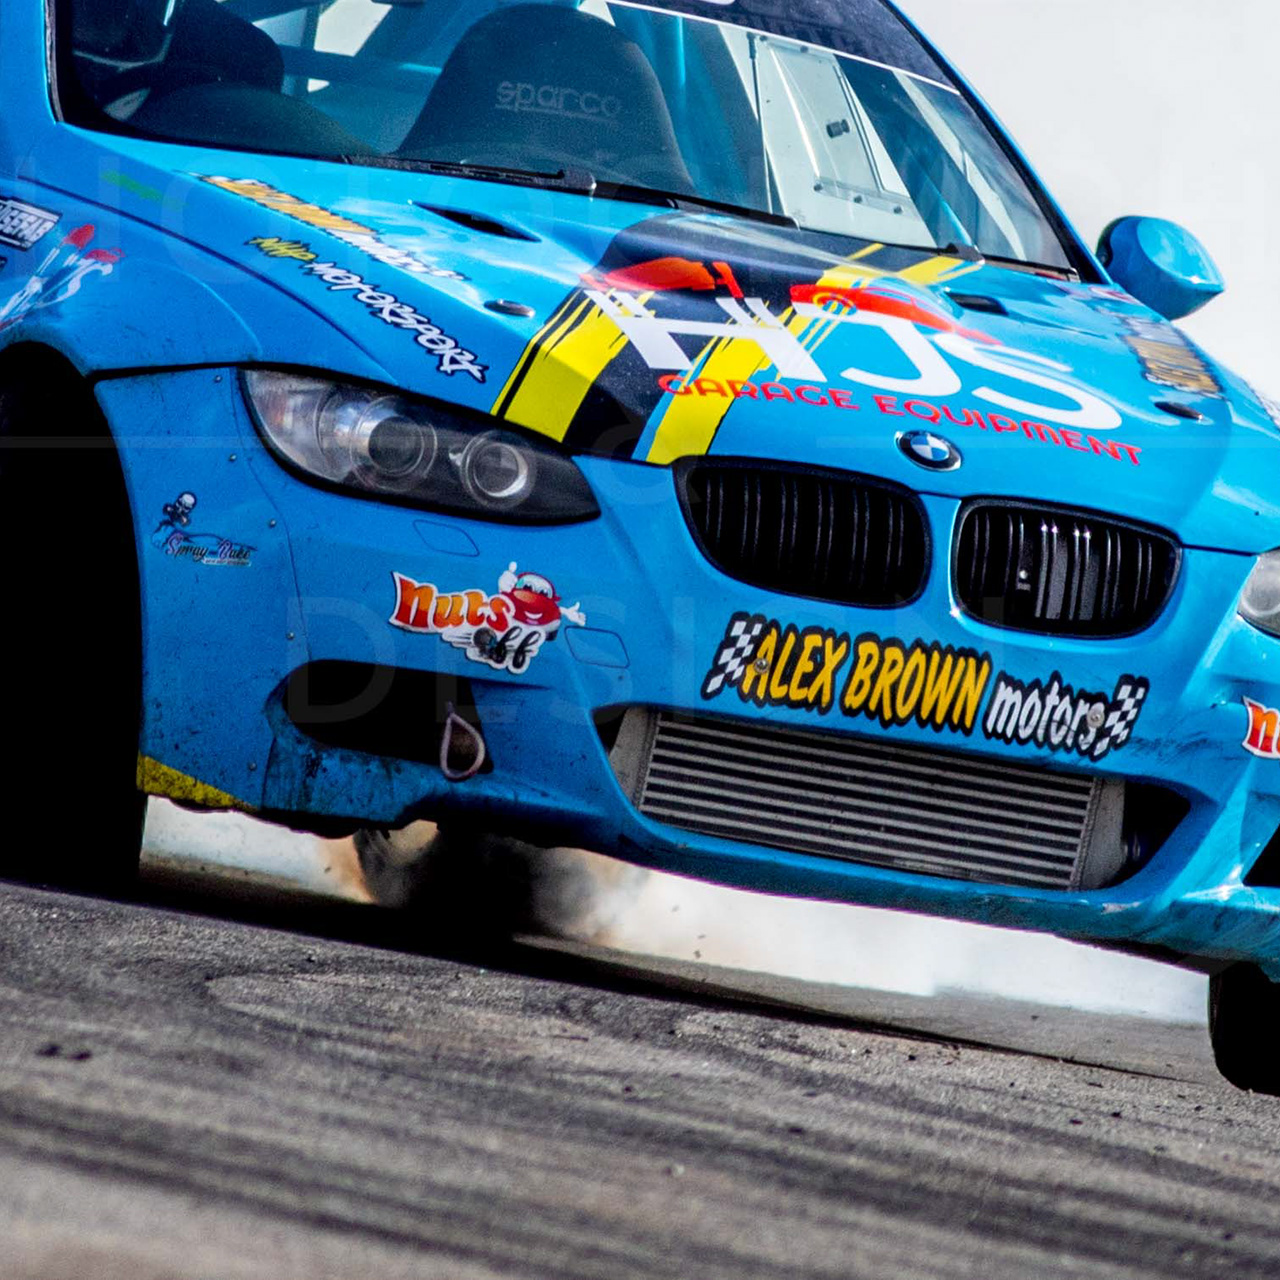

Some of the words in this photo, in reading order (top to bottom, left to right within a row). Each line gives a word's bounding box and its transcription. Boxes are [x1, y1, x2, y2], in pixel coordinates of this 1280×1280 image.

[495, 80, 622, 117] sparco
[302, 261, 487, 382] MOTORSPORT
[583, 290, 1122, 430] HJS
[658, 373, 861, 411] GARAGE
[874, 394, 1142, 466] EQUIPMENT
[741, 627, 848, 708] ALEX
[845, 640, 990, 730] BROWN
[985, 680, 1105, 751] motors
